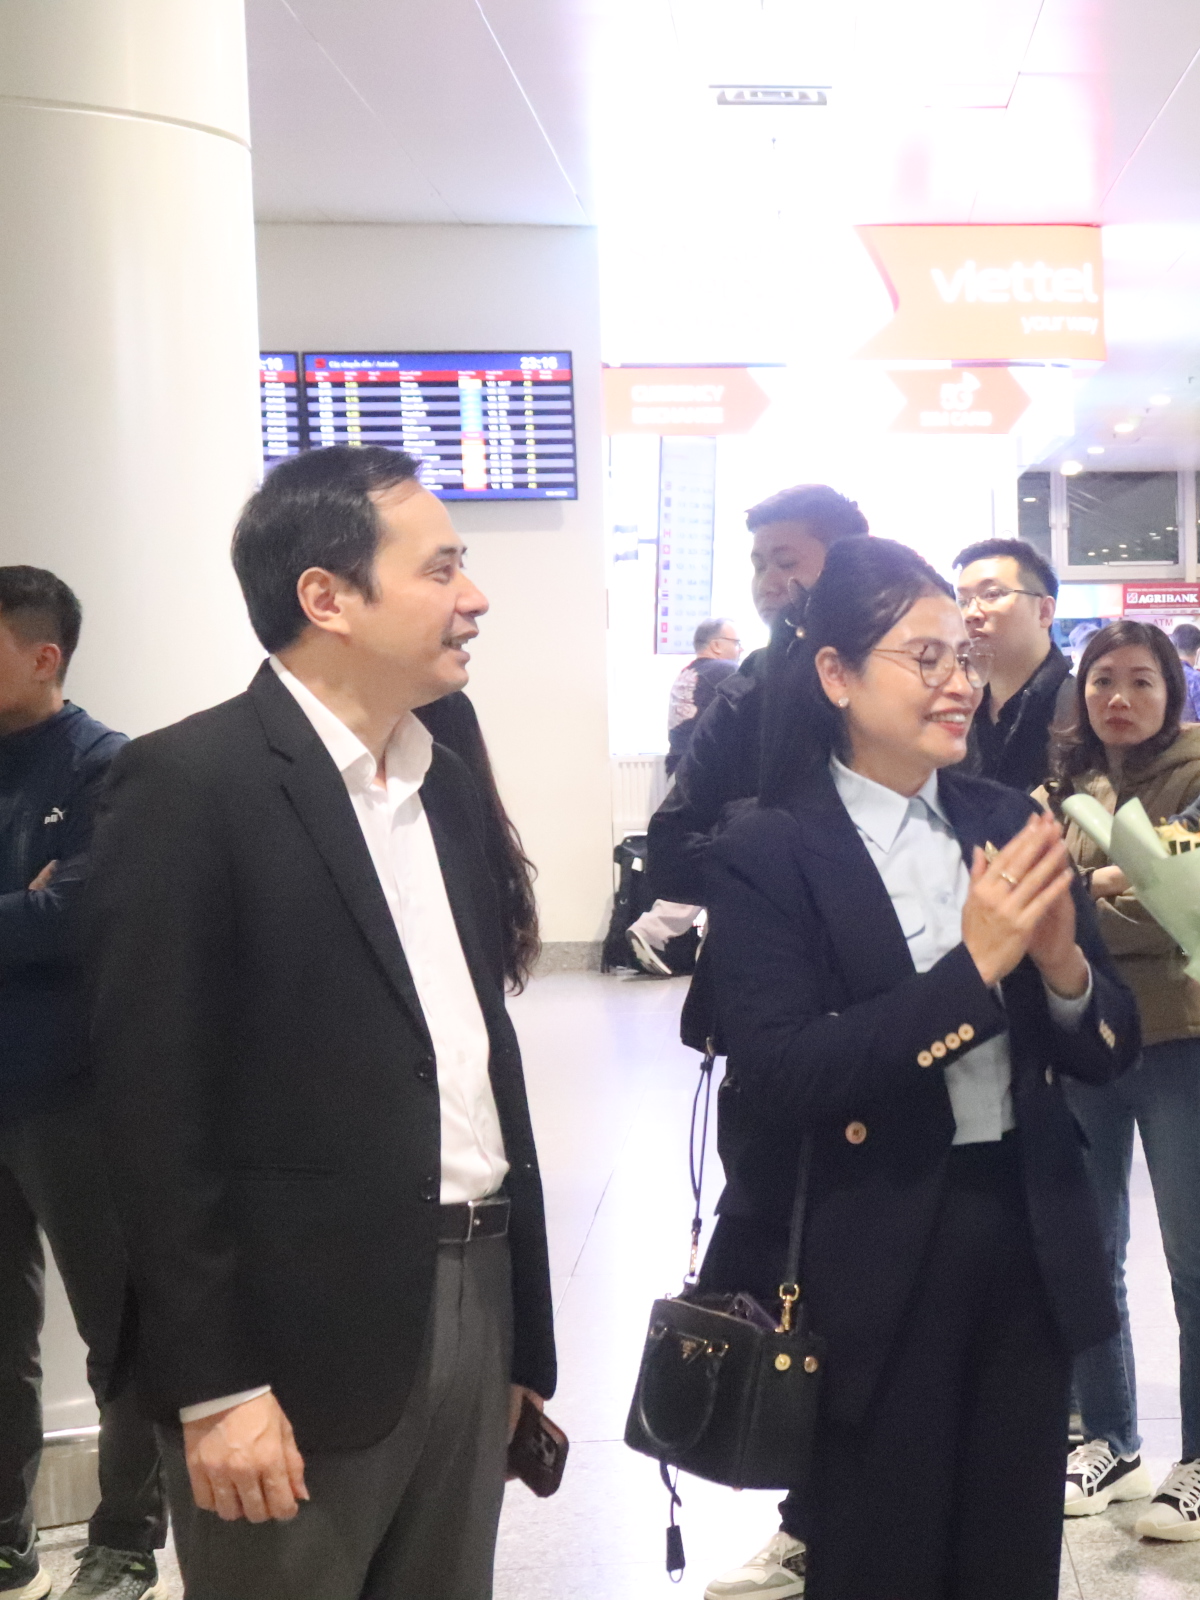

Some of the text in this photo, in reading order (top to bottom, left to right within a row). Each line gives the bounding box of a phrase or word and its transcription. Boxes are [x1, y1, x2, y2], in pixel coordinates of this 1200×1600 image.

[931, 260, 1099, 303] viettel
[1021, 315, 1099, 335] your way
[1138, 594, 1198, 603] AGRIBANK
